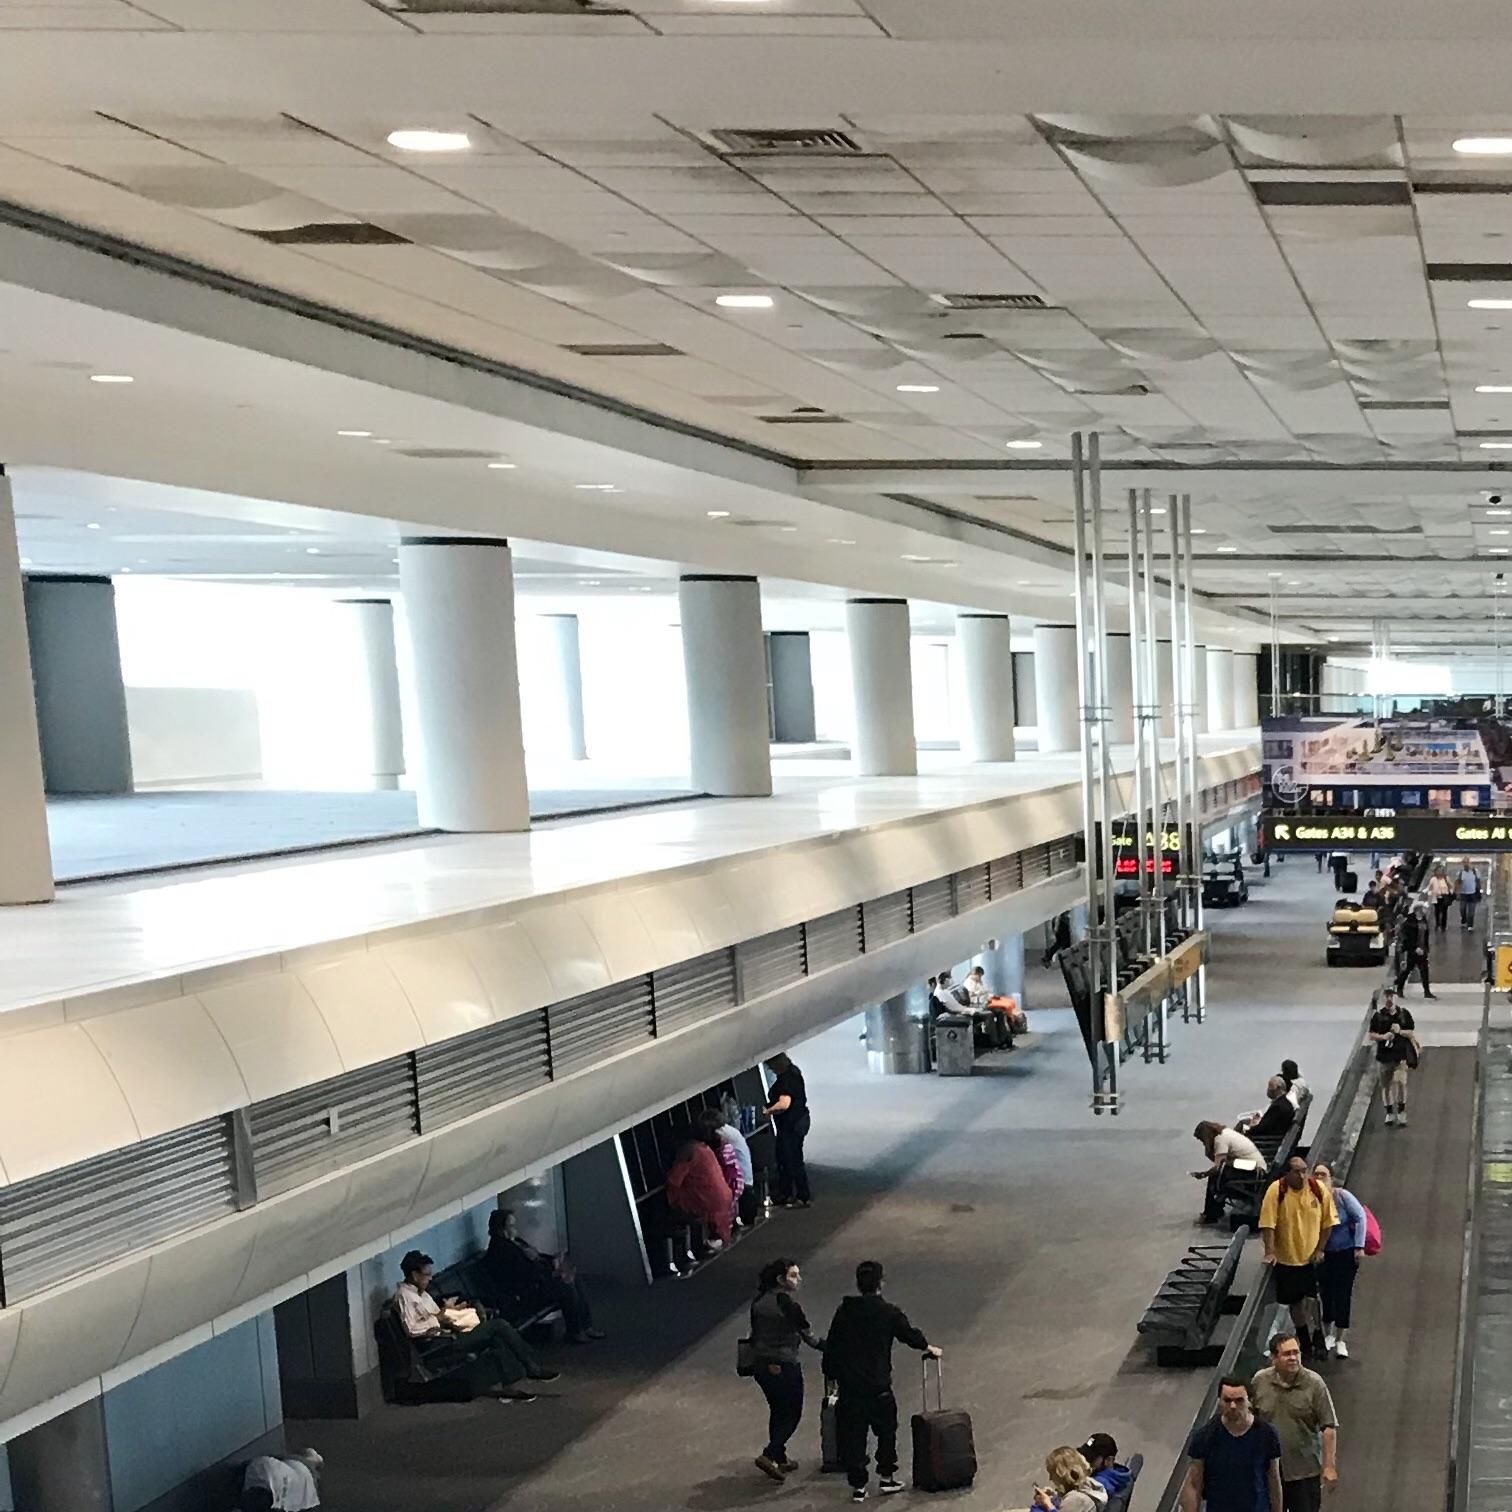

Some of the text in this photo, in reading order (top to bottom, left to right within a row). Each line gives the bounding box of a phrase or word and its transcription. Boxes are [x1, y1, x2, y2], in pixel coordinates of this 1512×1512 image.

[1296, 827, 1395, 839] Gates A34 & A36
[1456, 827, 1489, 839] Gates
[1491, 827, 1506, 839] A1
